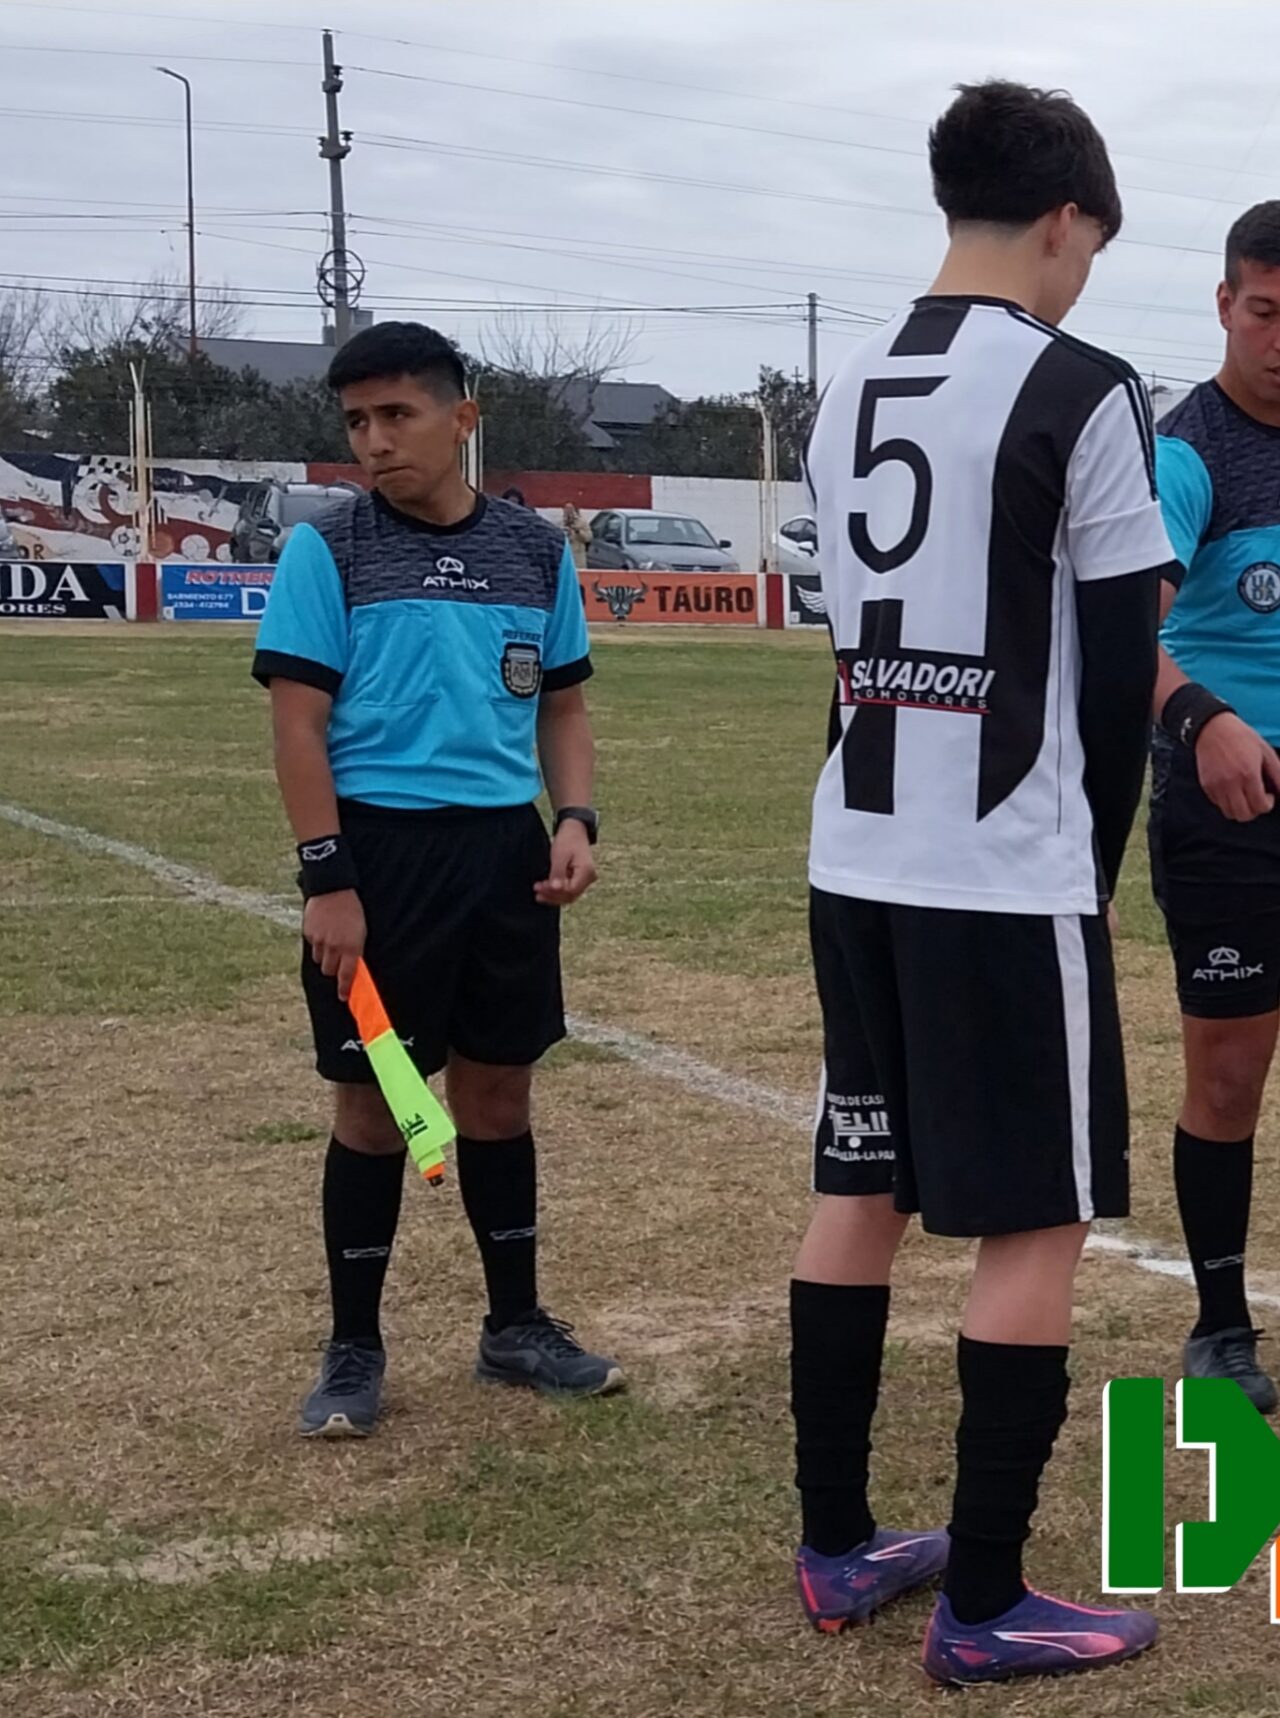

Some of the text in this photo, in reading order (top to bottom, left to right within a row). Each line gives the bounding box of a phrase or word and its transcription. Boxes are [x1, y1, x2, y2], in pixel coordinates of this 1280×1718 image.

[848, 375, 952, 574] 5
[0, 564, 91, 601] DA
[423, 575, 490, 591] ATHIX
[653, 585, 755, 613] TAURO
[1192, 963, 1264, 981] ATHIX
